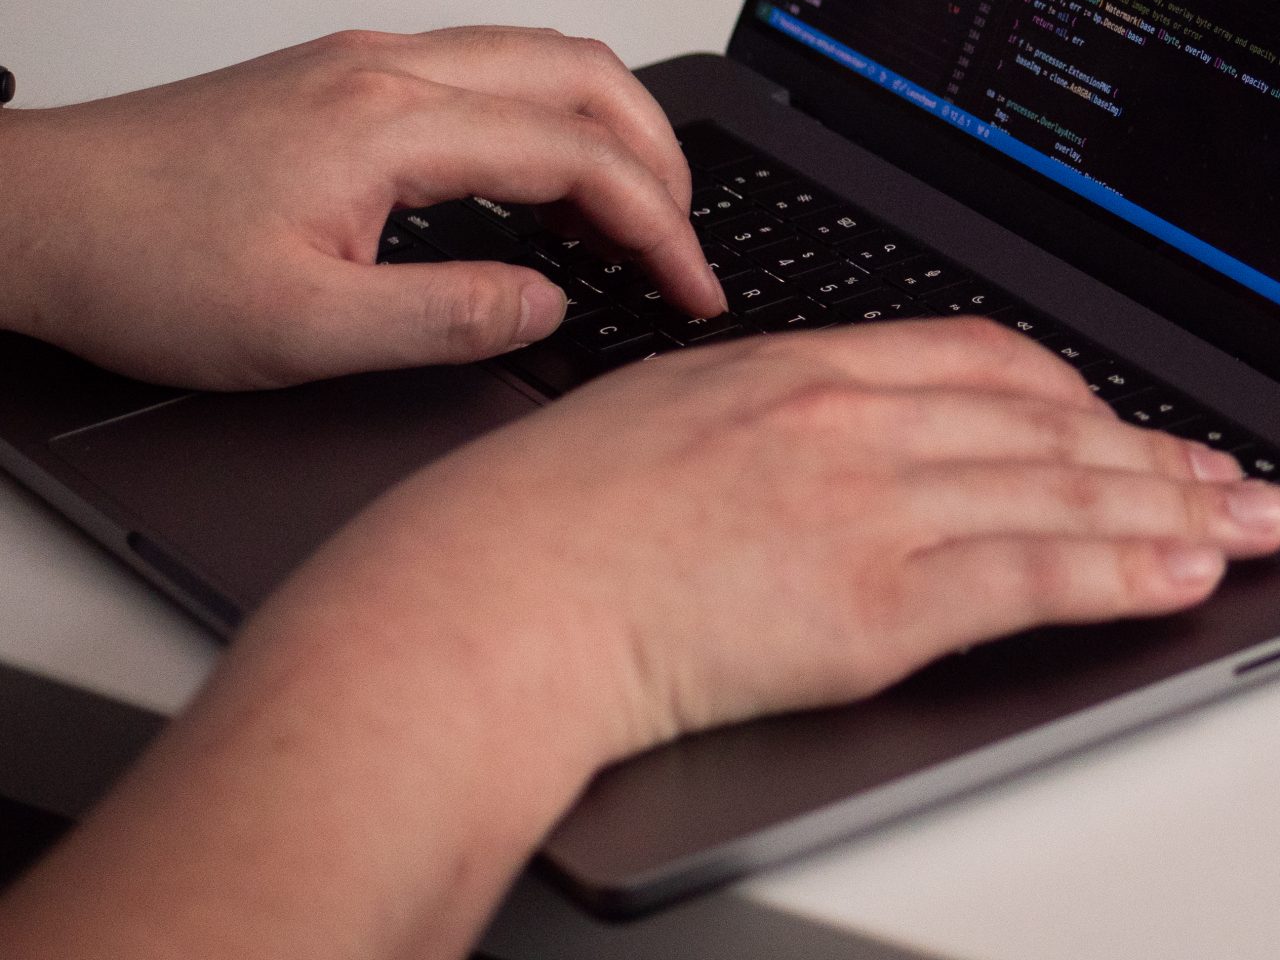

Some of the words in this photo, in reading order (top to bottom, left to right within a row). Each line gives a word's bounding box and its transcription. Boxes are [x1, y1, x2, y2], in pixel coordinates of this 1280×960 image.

[1068, 0, 1081, 12] err
[1056, 9, 1069, 22] nil
[1031, 12, 1054, 30] return
[1054, 24, 1071, 41] nil,
[1071, 35, 1083, 46] err
[1104, 1, 1155, 35] Watermark(base
[1183, 42, 1211, 64] overlay
[1240, 71, 1268, 94] opacity
[1014, 52, 1041, 74] baseImg
[1033, 46, 1110, 95] processor.ExtensionPNG
[693, 208, 711, 217] 2
[734, 232, 752, 241] 3
[562, 240, 580, 249] A
[604, 265, 622, 274] S
[820, 284, 838, 292] 5
[742, 289, 761, 298] R
[788, 314, 806, 323] T
[864, 310, 882, 319] 6
[599, 326, 618, 335] C
